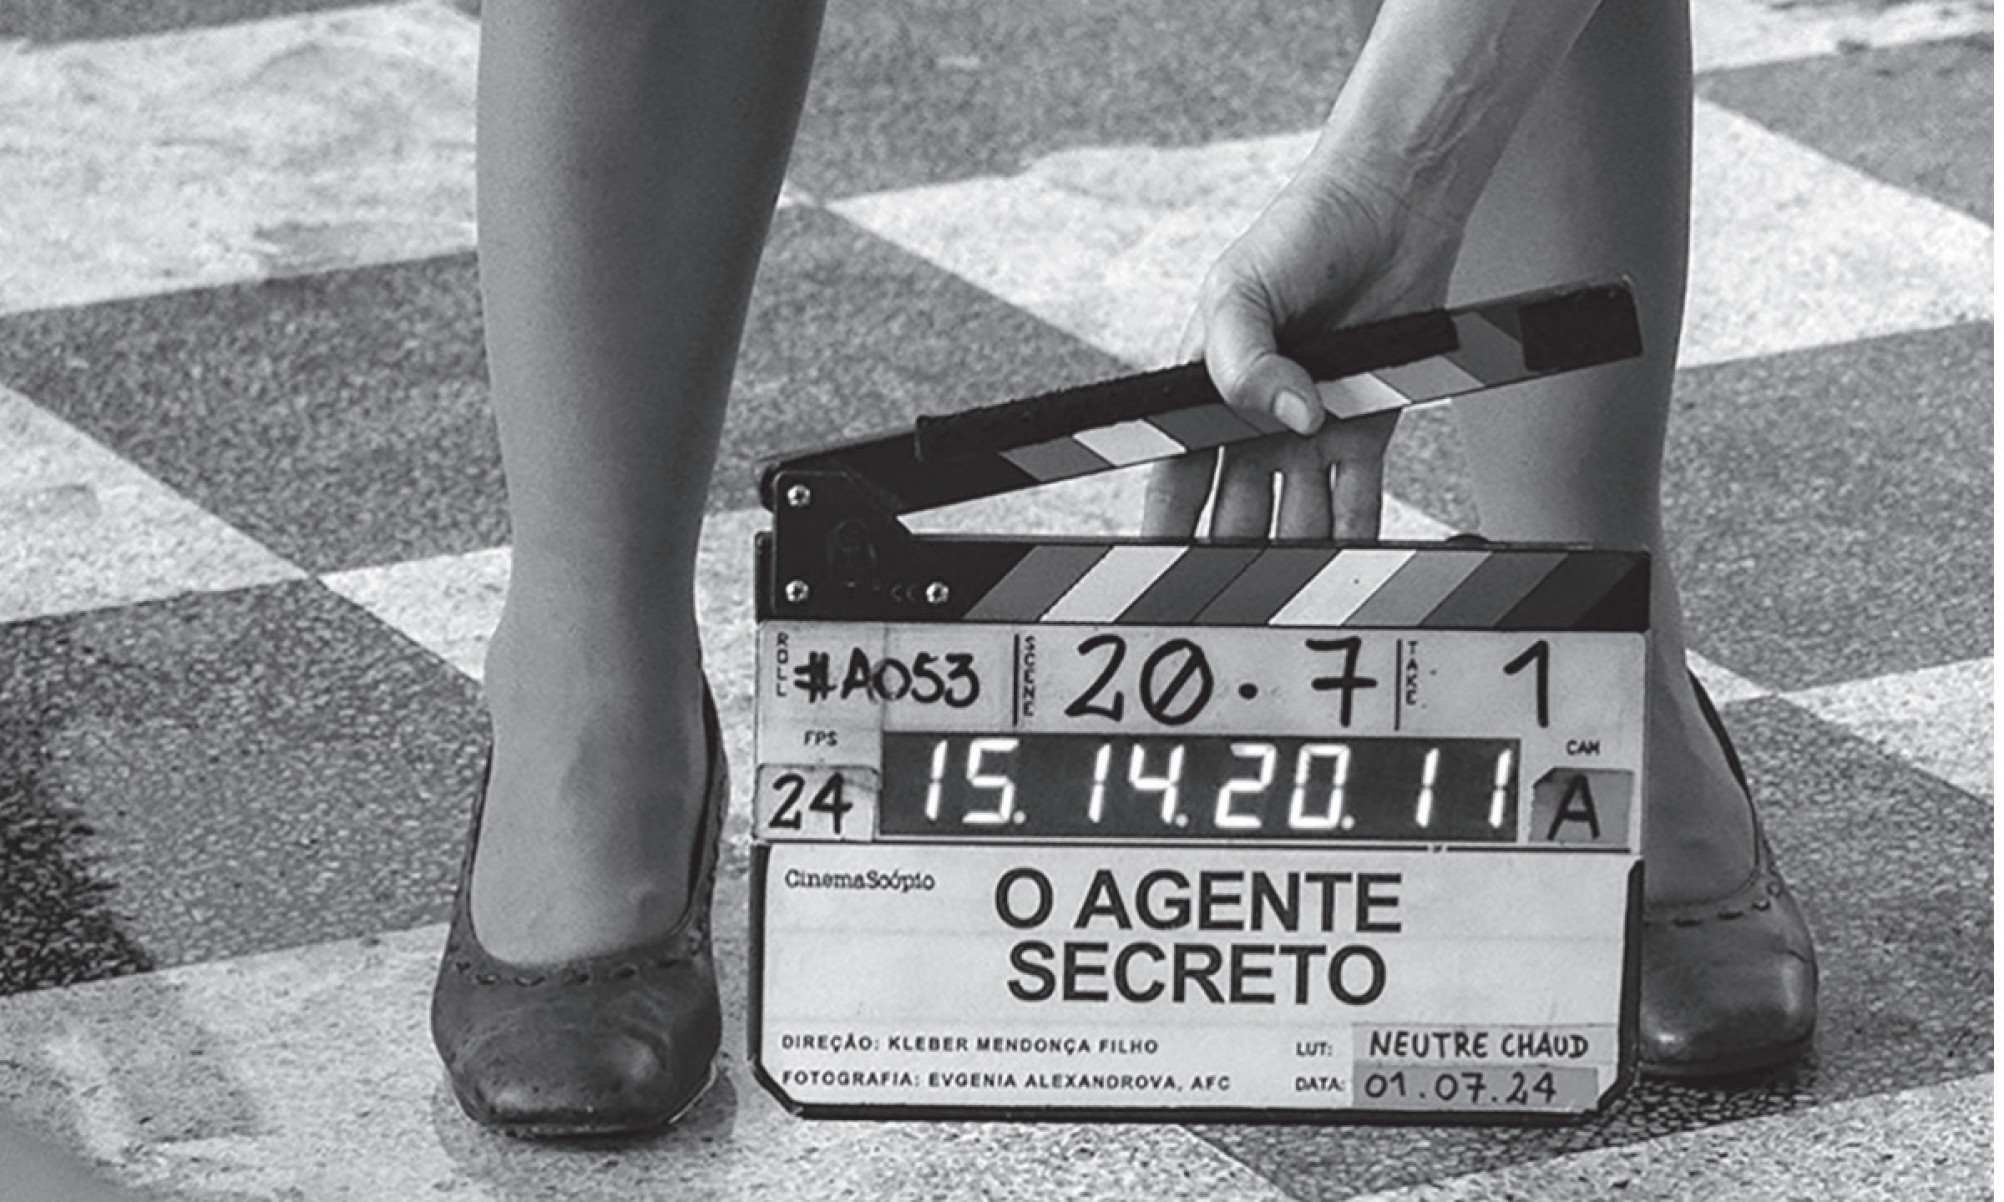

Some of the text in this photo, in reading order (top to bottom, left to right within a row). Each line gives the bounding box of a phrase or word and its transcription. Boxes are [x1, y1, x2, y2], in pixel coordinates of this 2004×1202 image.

[776, 631, 789, 697] ROLL
[793, 647, 980, 709] #A053
[1022, 635, 1036, 717] SCENE
[1405, 640, 1419, 706] TAKE
[1503, 639, 1549, 729] 1
[804, 730, 838, 747] FPS
[1566, 739, 1601, 756] CAM
[768, 772, 854, 834] 24
[1548, 773, 1601, 841] A
[994, 867, 1402, 933] O AGENTE
[1007, 940, 1387, 1006] SECRETO
[782, 1033, 1158, 1056] DIREÇÃO: KLEBER MENDONÇA FILHO
[1296, 1041, 1332, 1057] LUT:
[1370, 1030, 1589, 1059] NEUTRE CHAUD
[781, 1070, 1230, 1092] FOTOGRAFIA: EVGENIA ALEXANDROVA, AFC
[1295, 1076, 1345, 1092] DATA:
[1365, 1071, 1557, 1104] 01.07.24
